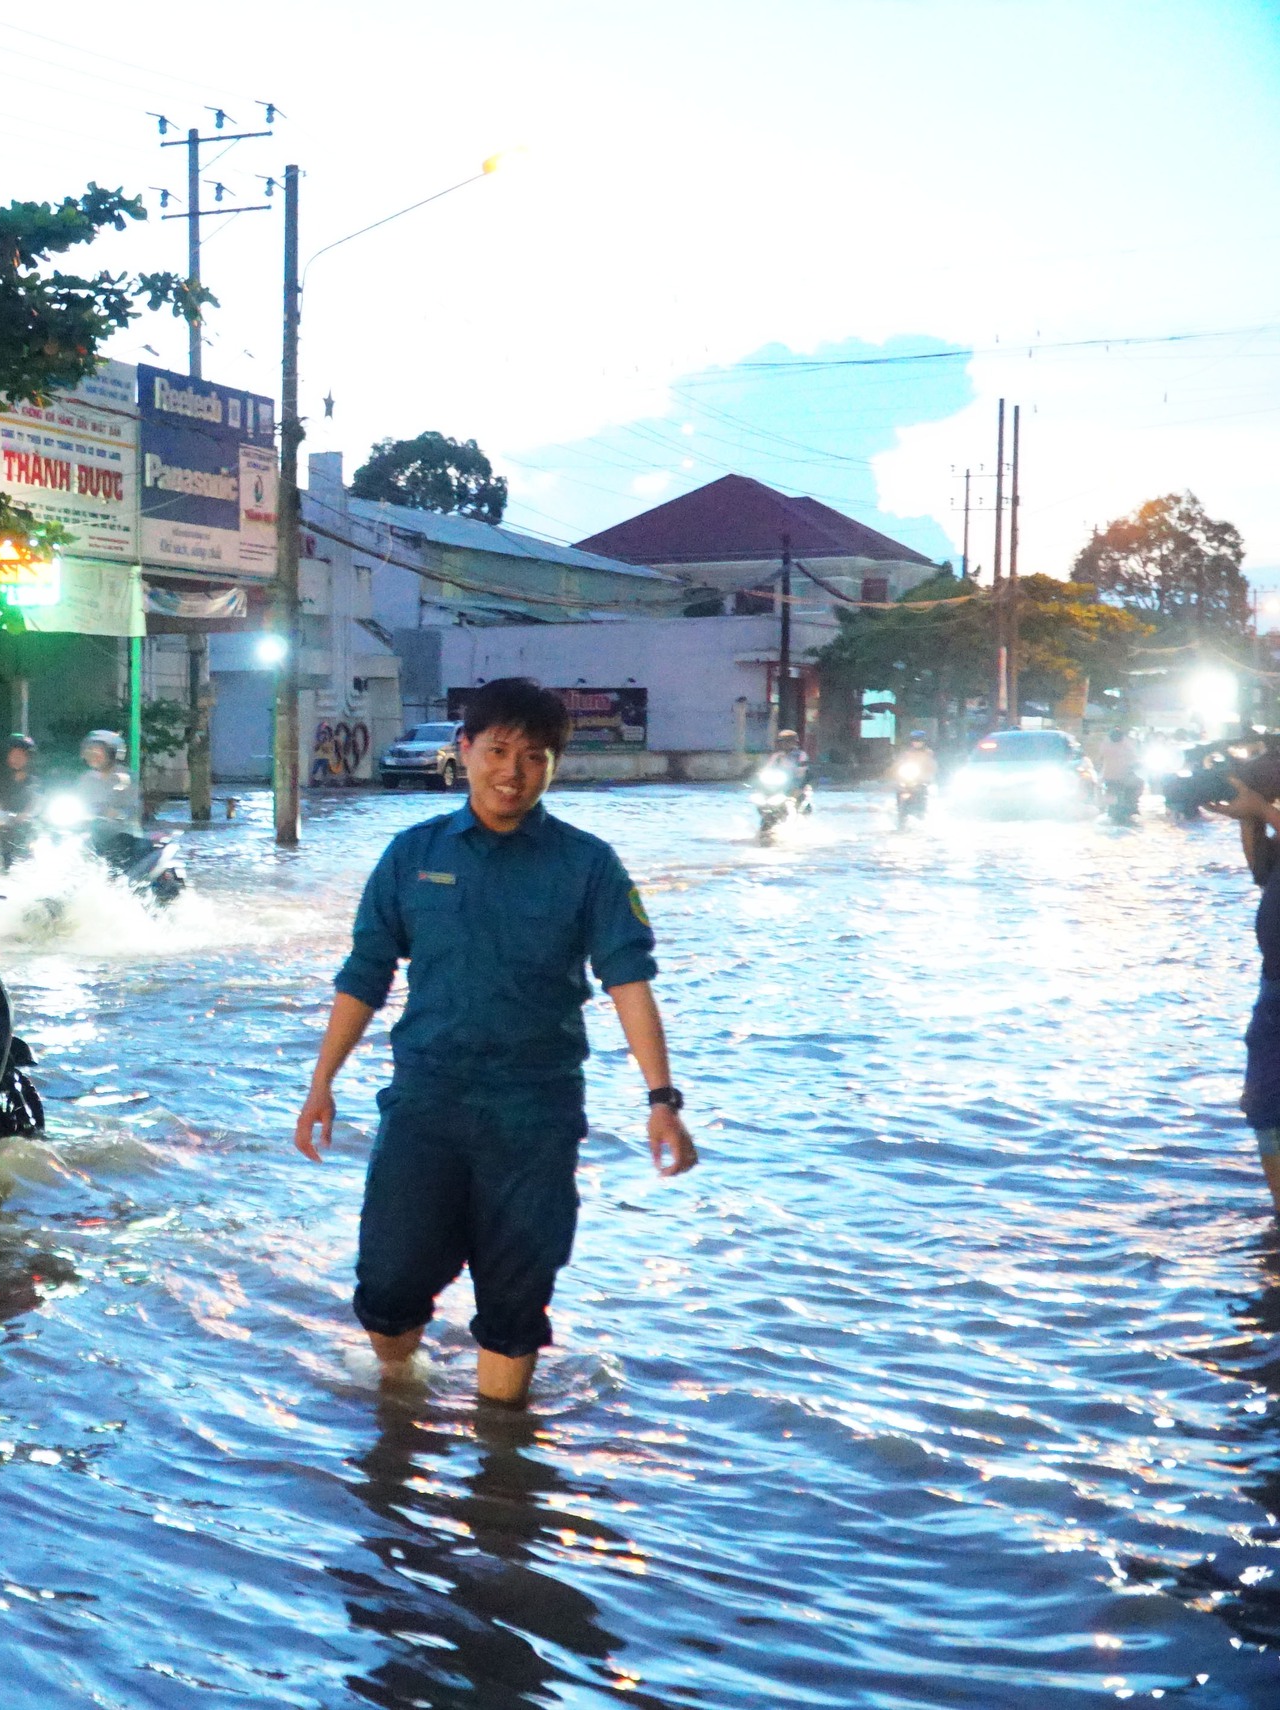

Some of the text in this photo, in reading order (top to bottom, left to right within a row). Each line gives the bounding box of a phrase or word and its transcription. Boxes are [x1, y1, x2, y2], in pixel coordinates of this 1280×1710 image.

[154, 376, 222, 423] Reetech
[3, 448, 124, 505] THÀNH ĐƯỢC
[145, 453, 238, 501] Panasonic
